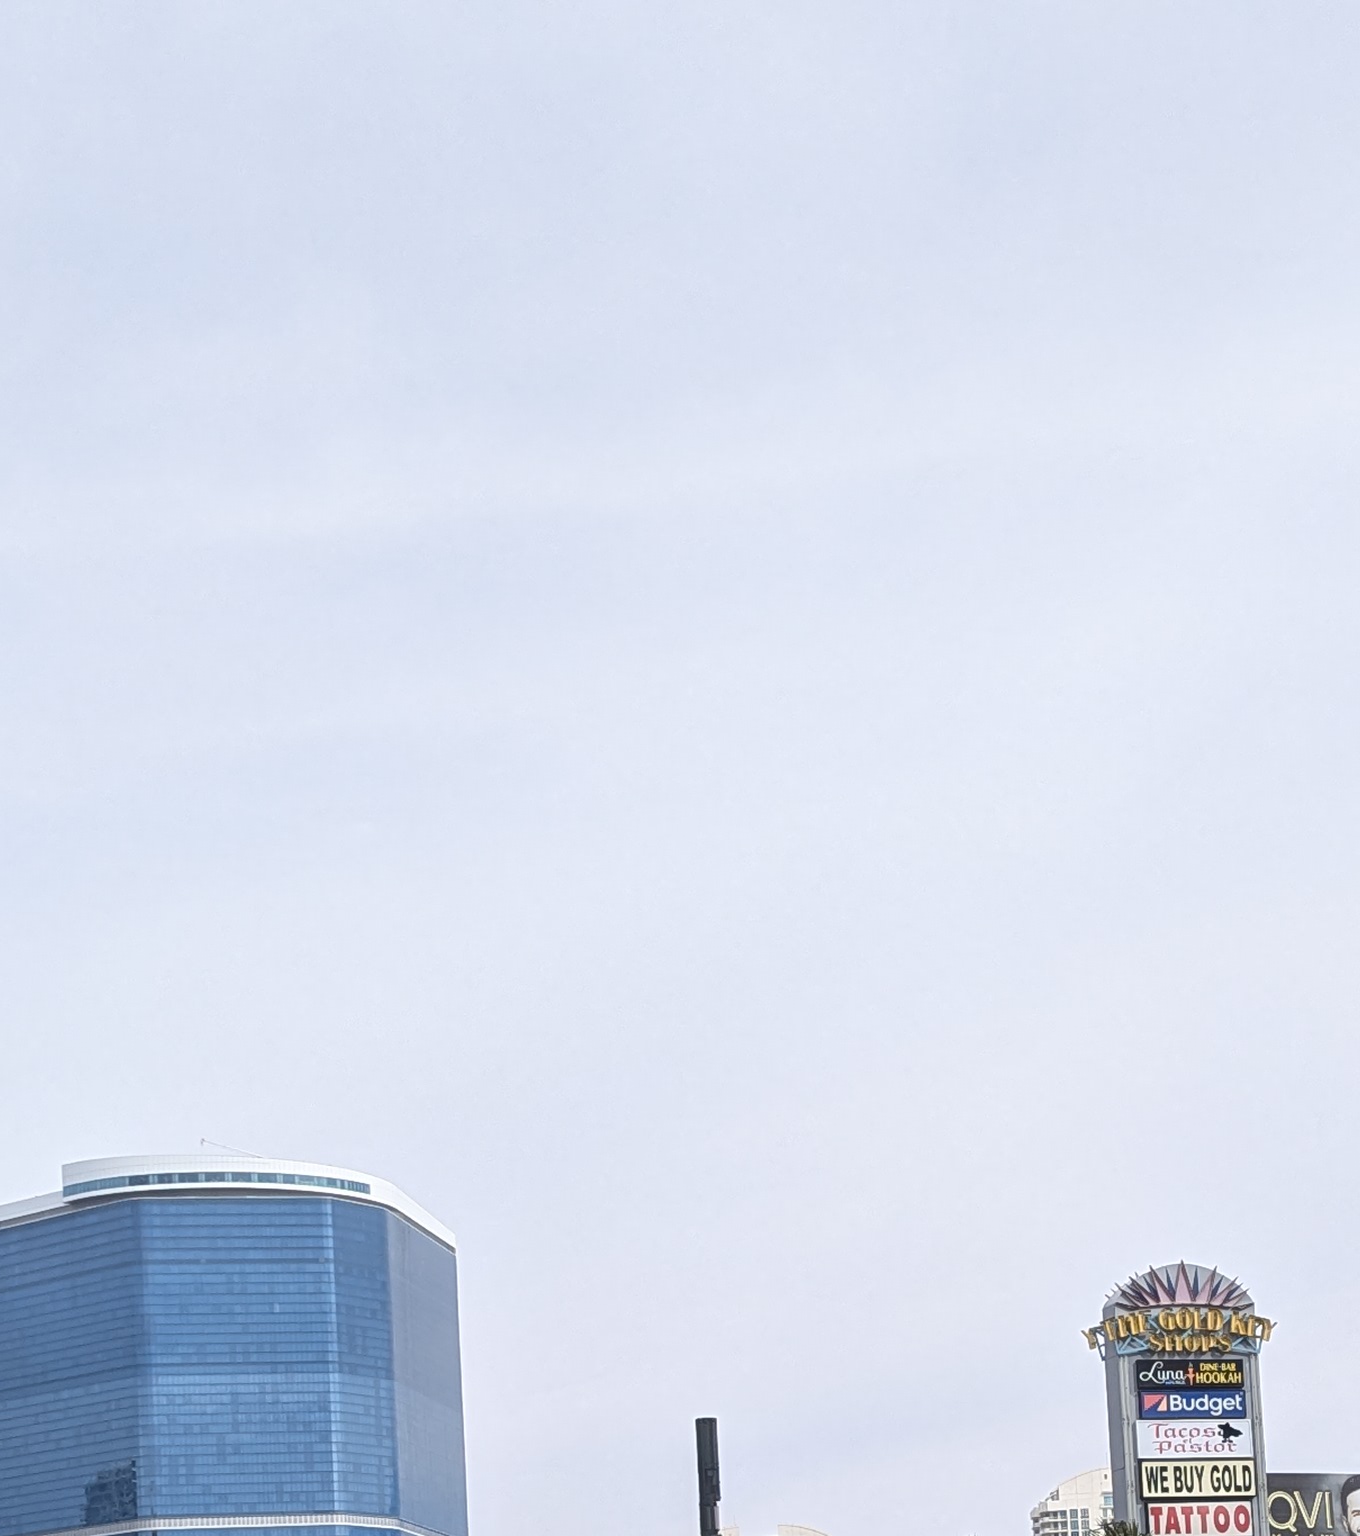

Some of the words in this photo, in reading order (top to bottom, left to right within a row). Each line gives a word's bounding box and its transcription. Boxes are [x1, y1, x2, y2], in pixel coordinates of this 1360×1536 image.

[1103, 1310, 1151, 1340] THE
[1158, 1306, 1224, 1331] GOLD
[1229, 1311, 1278, 1342] KEY
[1149, 1332, 1232, 1353] SHOPS
[1195, 1371, 1243, 1385] HOOKAH
[1169, 1394, 1243, 1416] Budget
[1147, 1421, 1217, 1440] Tacos
[1151, 1440, 1238, 1455] Pastor
[1144, 1465, 1170, 1494] WE
[1173, 1464, 1205, 1493] BUY
[1210, 1464, 1252, 1493] GOLD
[1150, 1504, 1251, 1535] TATTOO
[1267, 1490, 1334, 1532] QVI
